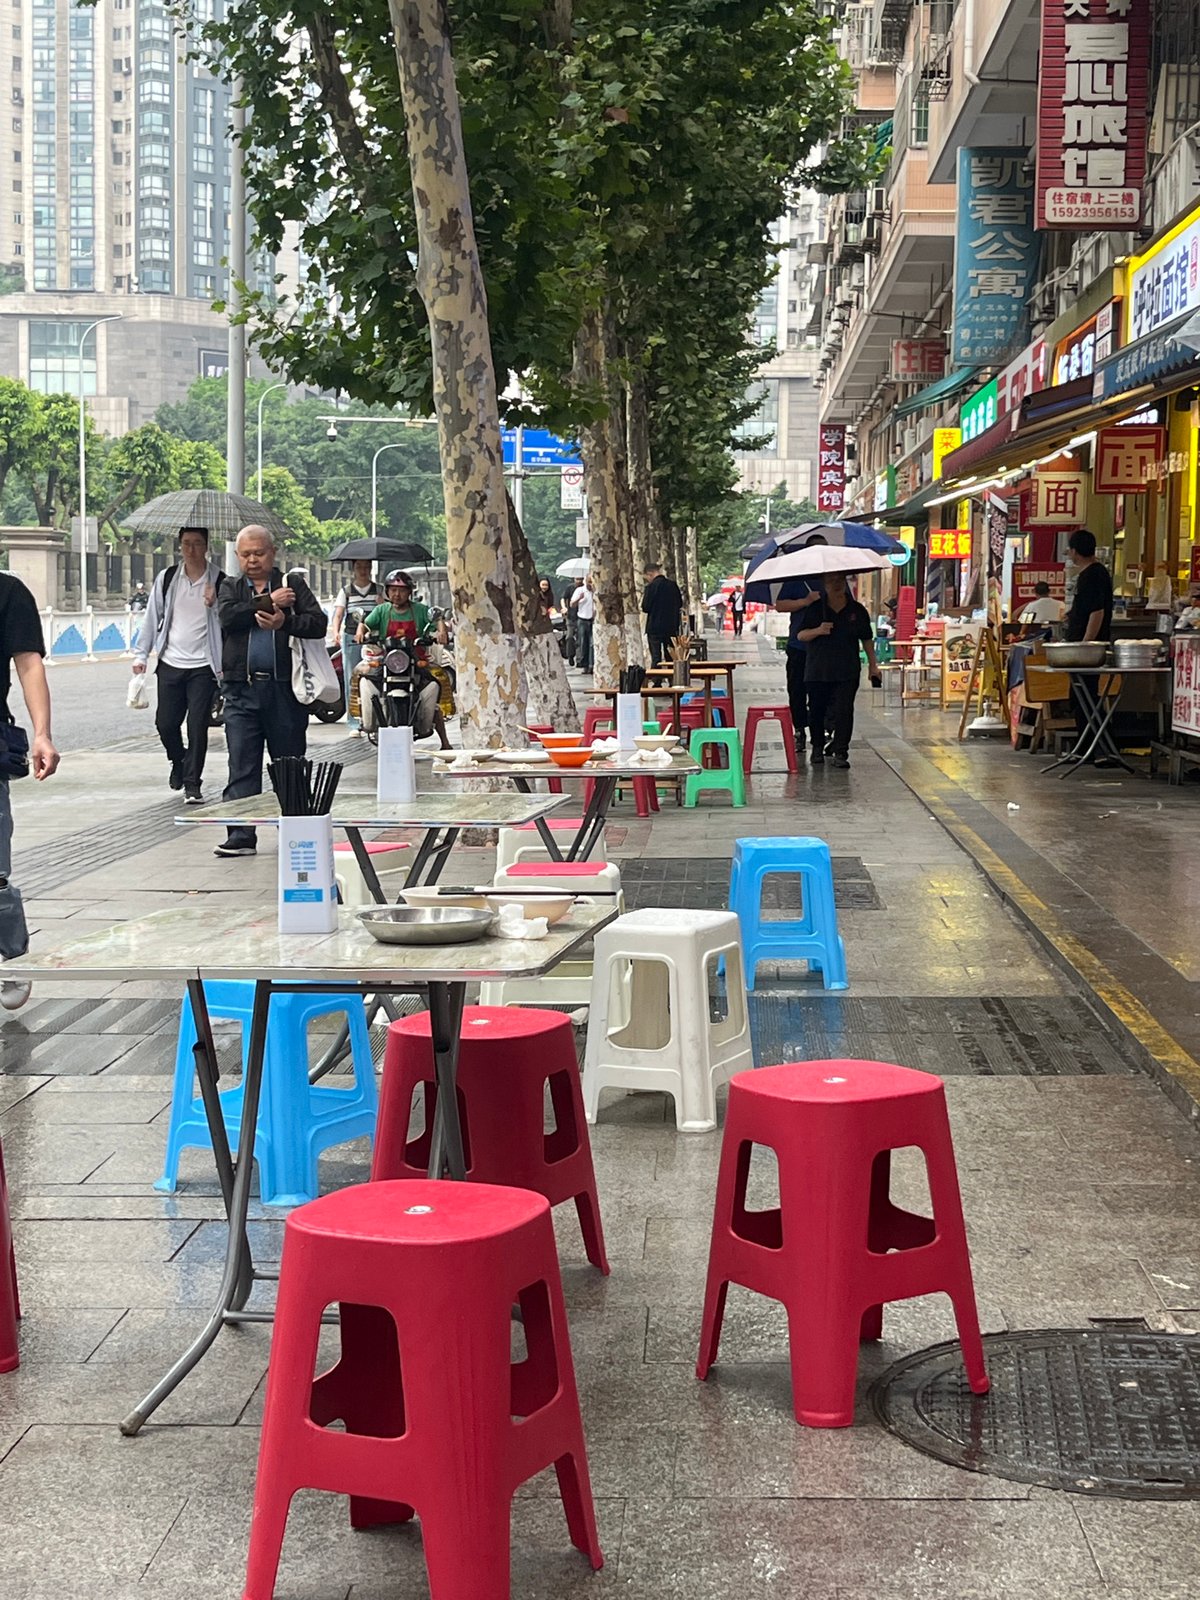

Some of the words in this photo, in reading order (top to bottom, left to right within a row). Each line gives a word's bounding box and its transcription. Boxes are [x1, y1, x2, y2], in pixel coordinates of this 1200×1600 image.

[1052, 192, 1134, 205] 住宿请上二楼
[1052, 207, 1135, 218] 15923956153
[968, 156, 1034, 299] 凯君公寓
[895, 341, 945, 372] 住宿
[819, 429, 843, 506] 学院宾馆
[1044, 479, 1082, 517] 面
[929, 533, 971, 555] 豆花饭
